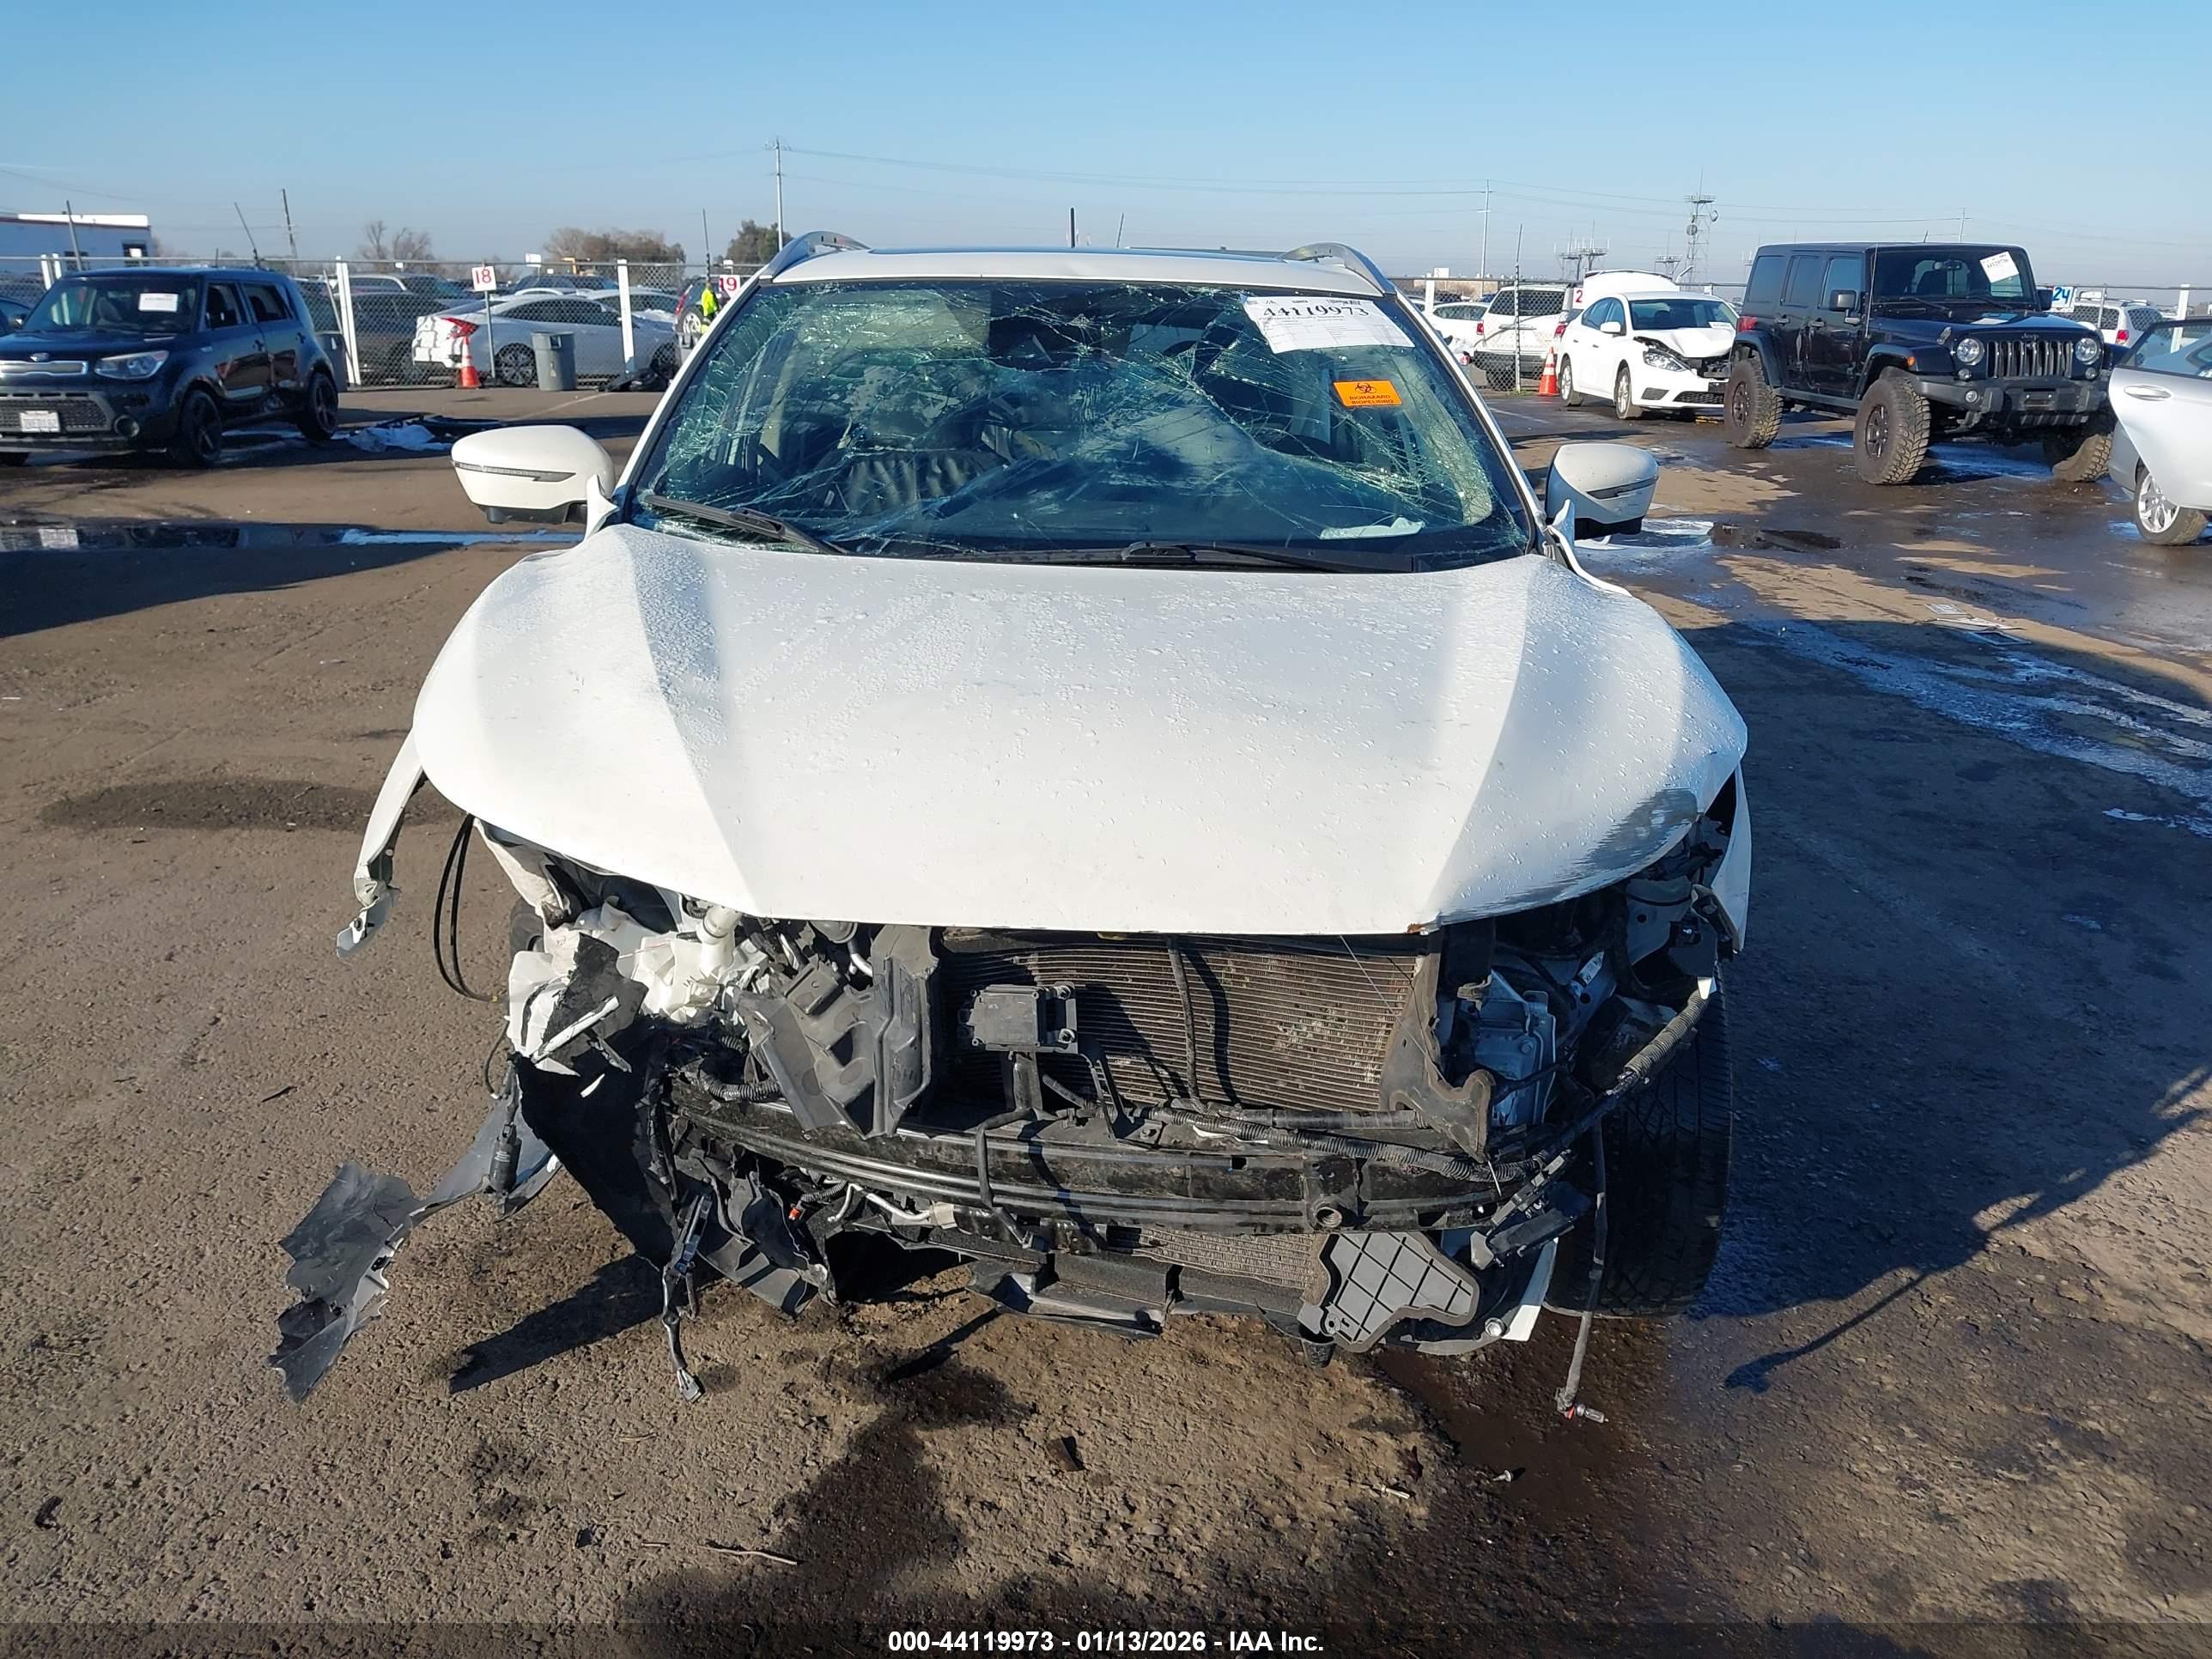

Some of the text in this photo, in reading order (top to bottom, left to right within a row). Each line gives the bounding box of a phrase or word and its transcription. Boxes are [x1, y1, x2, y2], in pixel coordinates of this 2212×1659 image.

[475, 269, 491, 284] 18
[719, 276, 738, 291] 19
[2052, 287, 2070, 304] 24
[1263, 304, 1370, 317] 44119973
